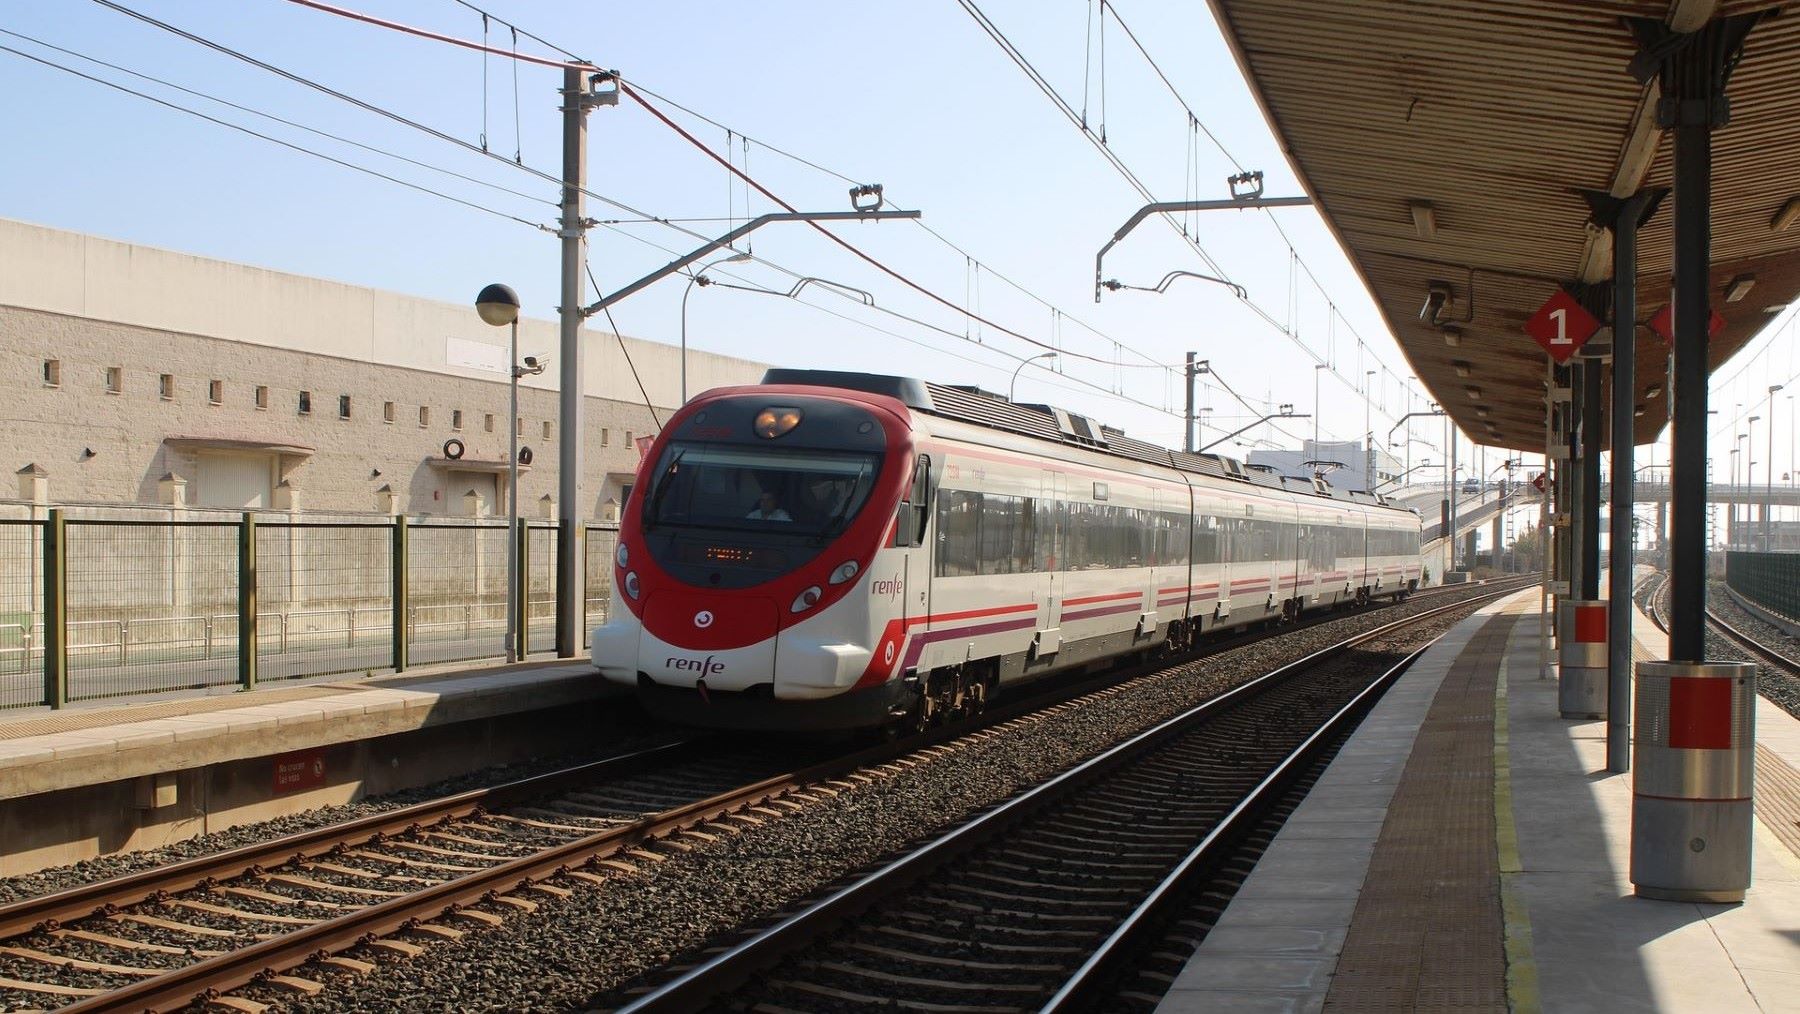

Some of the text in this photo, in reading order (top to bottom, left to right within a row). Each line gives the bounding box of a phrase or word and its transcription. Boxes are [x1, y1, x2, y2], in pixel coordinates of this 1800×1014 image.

[1549, 308, 1573, 345] 1
[872, 572, 902, 603] renfe
[665, 655, 725, 679] renfe
